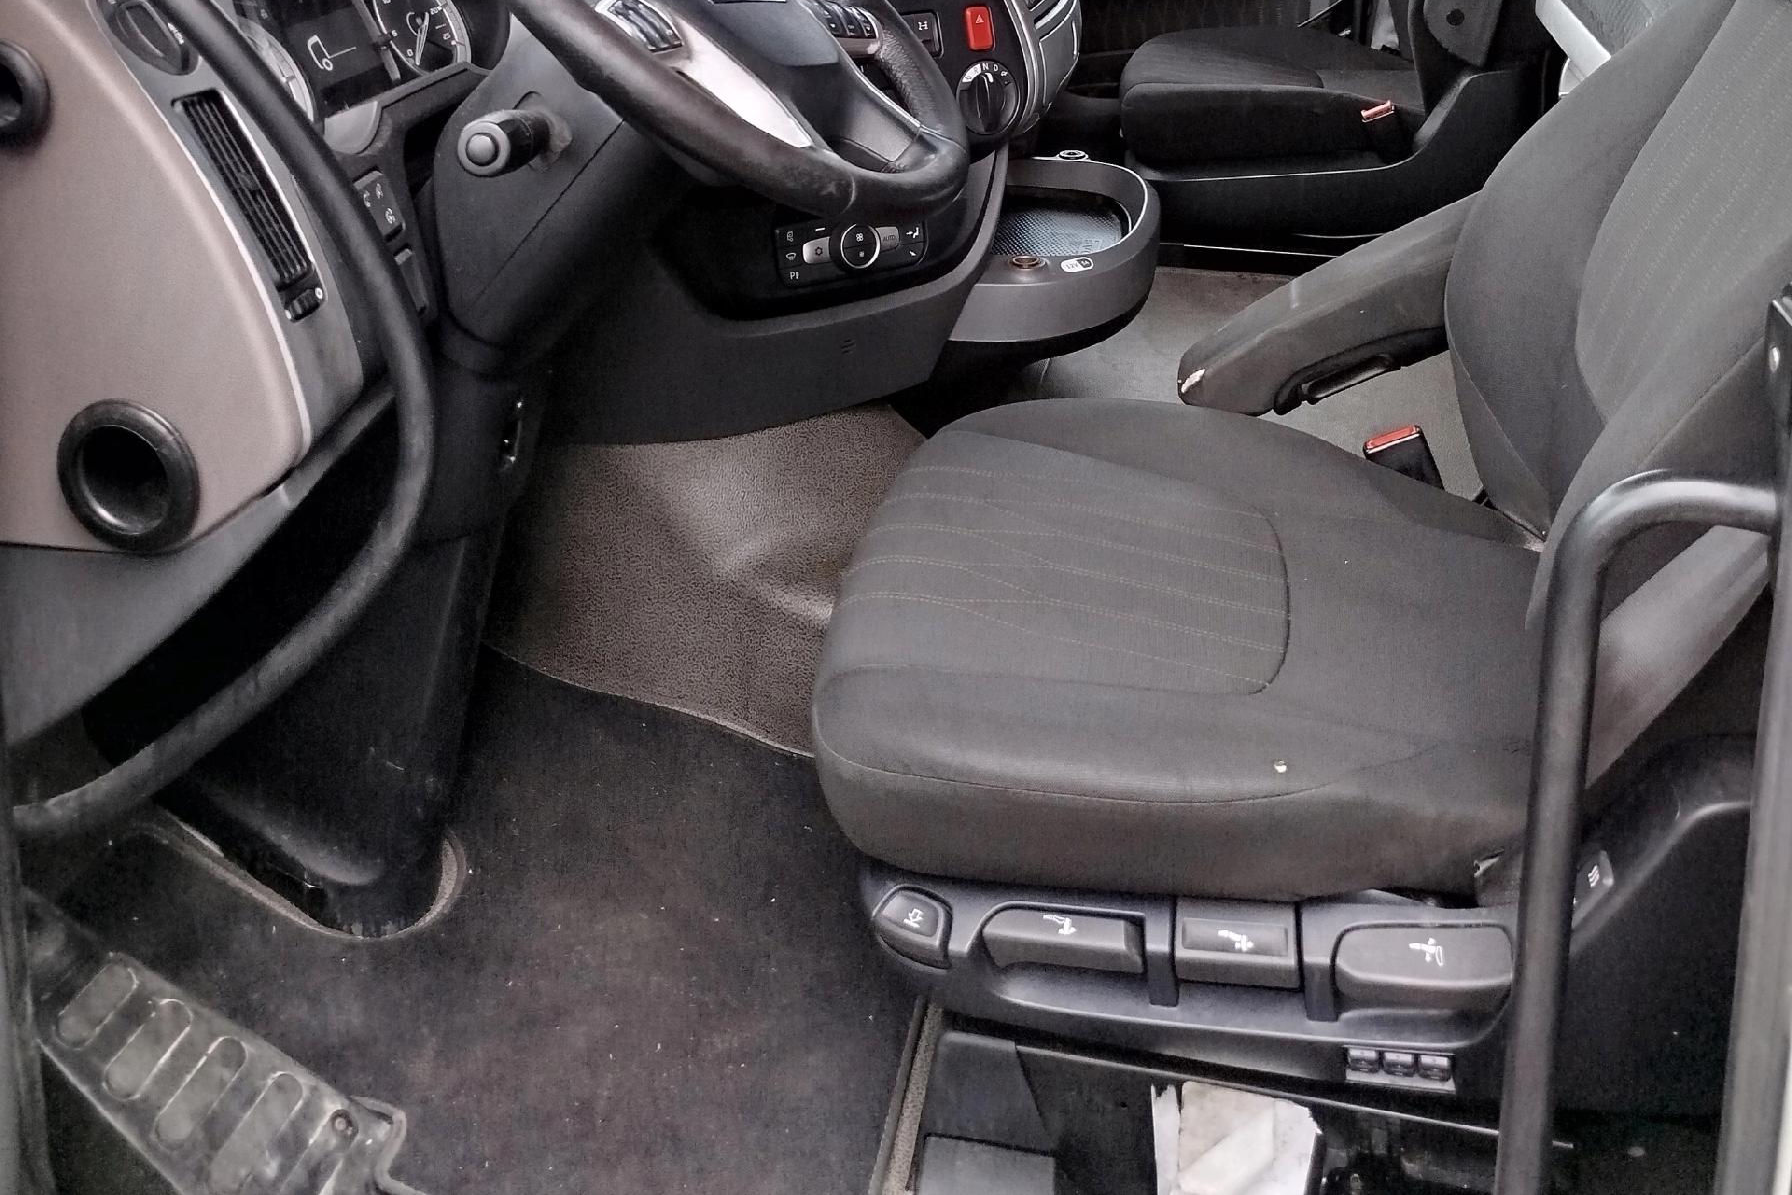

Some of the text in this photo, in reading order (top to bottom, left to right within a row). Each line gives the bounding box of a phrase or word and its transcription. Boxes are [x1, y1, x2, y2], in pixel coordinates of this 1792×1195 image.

[406, 48, 414, 57] 0
[982, 62, 989, 71] N
[993, 63, 999, 72] D
[882, 234, 896, 242] AUTO
